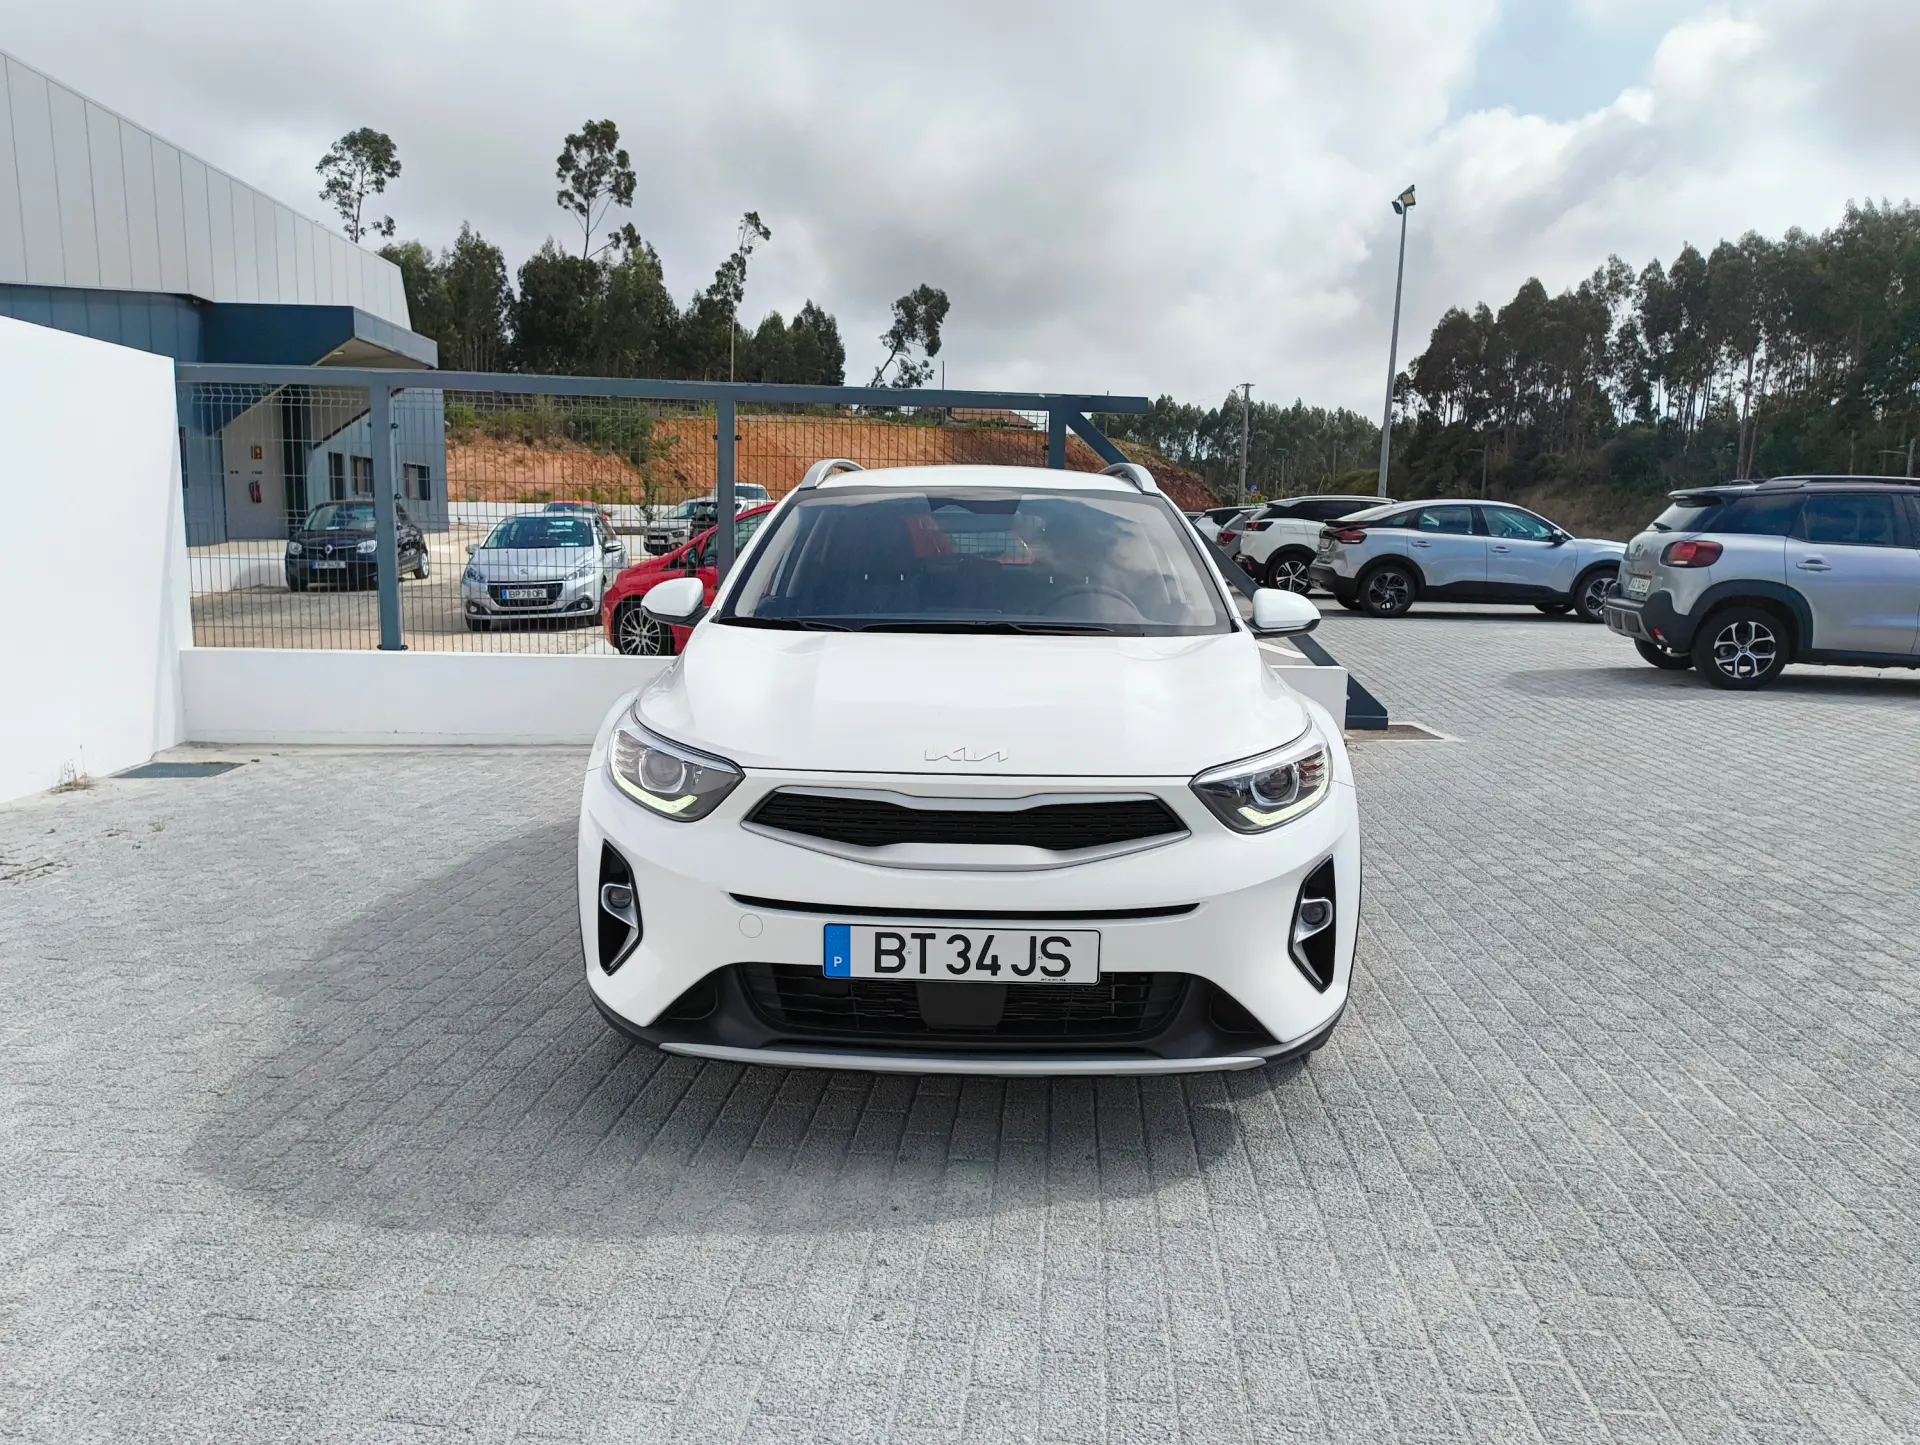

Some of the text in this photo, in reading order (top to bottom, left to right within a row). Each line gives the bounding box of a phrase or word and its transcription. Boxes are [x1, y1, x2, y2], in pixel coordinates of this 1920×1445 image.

[833, 956, 842, 968] P
[874, 931, 1072, 978] BT 34 JS
